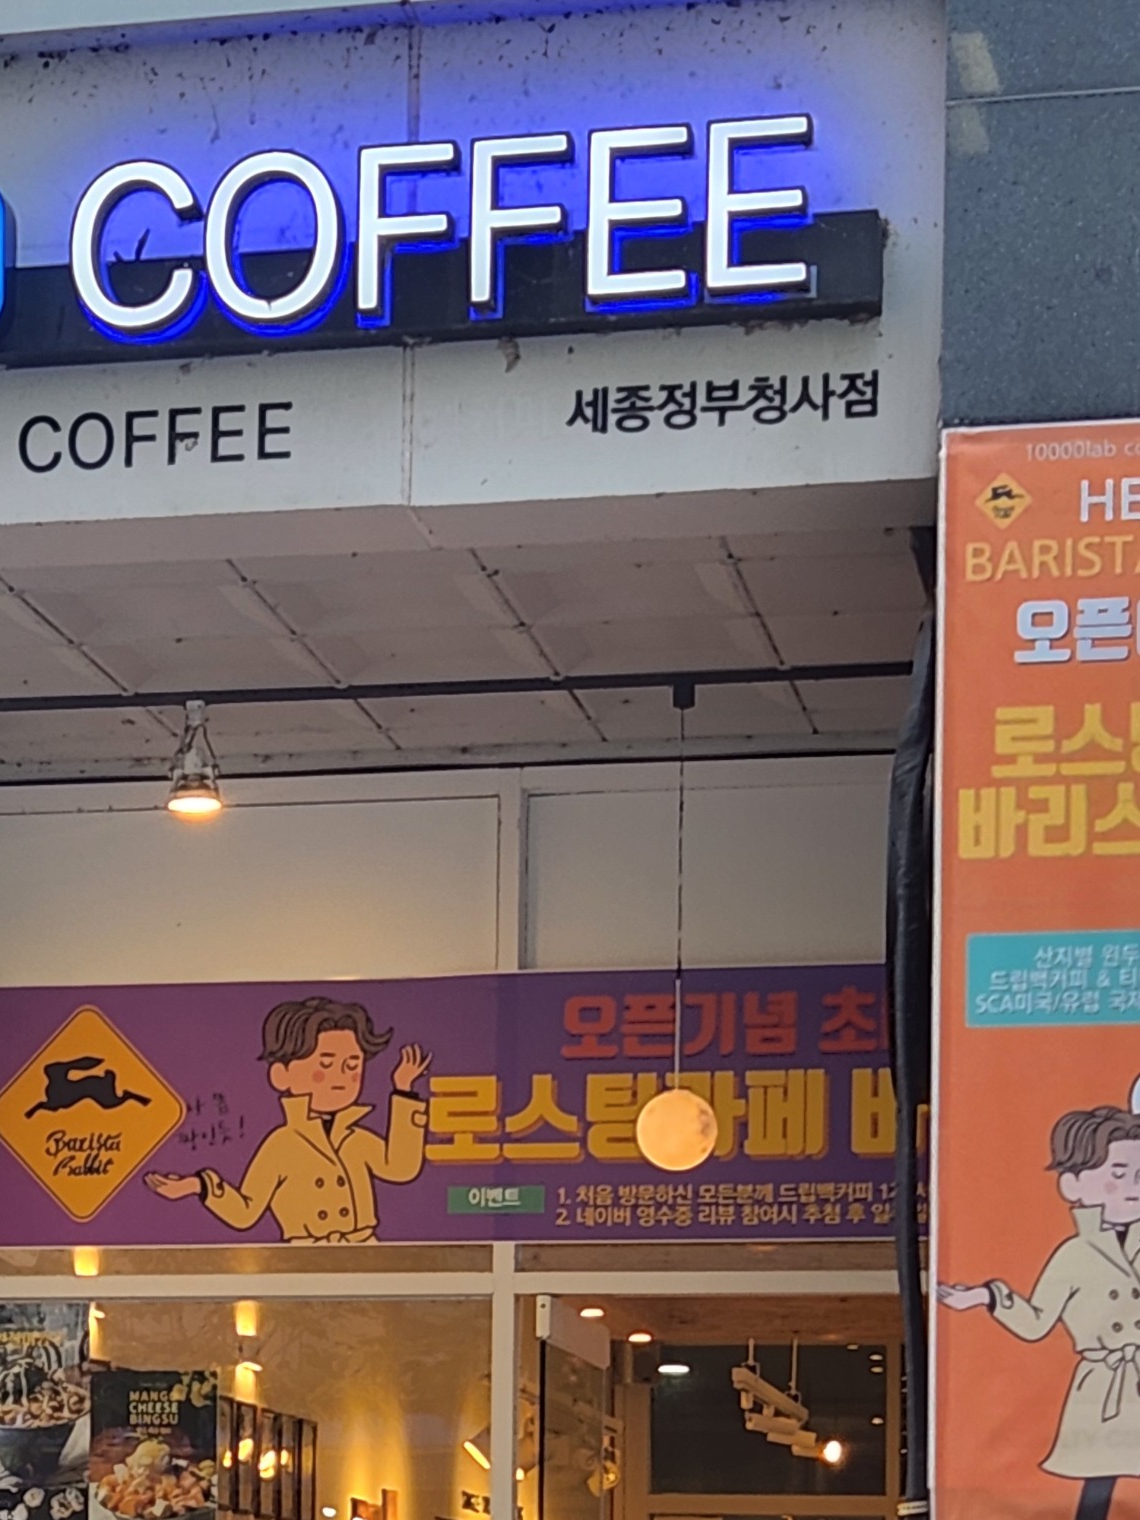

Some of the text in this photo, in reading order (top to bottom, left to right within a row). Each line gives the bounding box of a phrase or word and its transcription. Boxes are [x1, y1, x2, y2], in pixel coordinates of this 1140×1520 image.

[71, 114, 810, 331] COFFEE
[565, 369, 880, 435] 세종정부청사점
[18, 401, 293, 474] COFFEE
[1026, 439, 1117, 462] 10000lab
[964, 534, 1140, 583] BARIST
[1013, 596, 1140, 664] 오픈
[990, 702, 1140, 779] 로스
[560, 984, 889, 1061] 오픈기념 초
[45, 1129, 122, 1158] Barista
[466, 1186, 522, 1208] 이벤트
[575, 1184, 613, 1206] 처음
[618, 1183, 693, 1206] 방문하신
[697, 1182, 774, 1205] 모든분께
[778, 1181, 874, 1204] 드립백커피
[575, 1206, 632, 1227] 네이버
[636, 1205, 693, 1227] 영수증
[697, 1205, 735, 1226] 리뷰
[741, 1203, 798, 1226] 참여시
[802, 1203, 842, 1225] 추첨
[846, 1203, 867, 1225] 후
[128, 1390, 169, 1402] MANG
[128, 1401, 179, 1414] CHEESE
[128, 1413, 179, 1425] BINGSU
